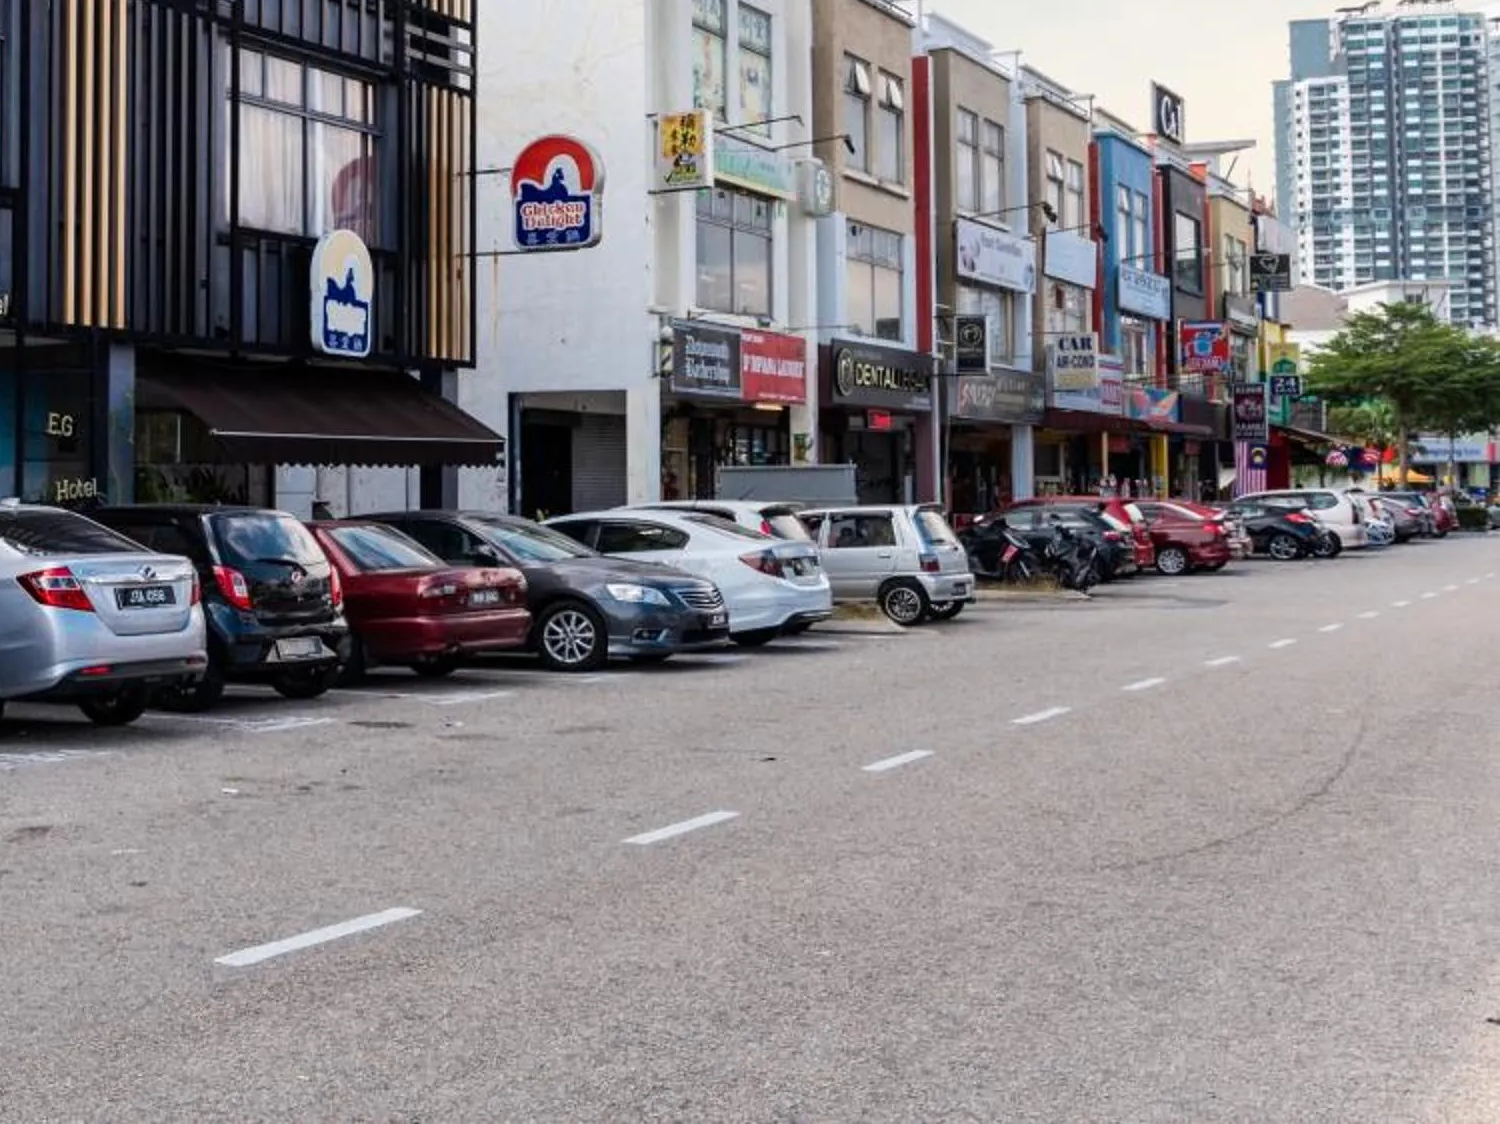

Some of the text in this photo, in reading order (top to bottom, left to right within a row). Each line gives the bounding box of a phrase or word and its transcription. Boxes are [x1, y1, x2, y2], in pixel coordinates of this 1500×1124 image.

[1058, 336, 1093, 352] CAR
[855, 363, 900, 389] DENTAL
[56, 478, 99, 501] Hotel
